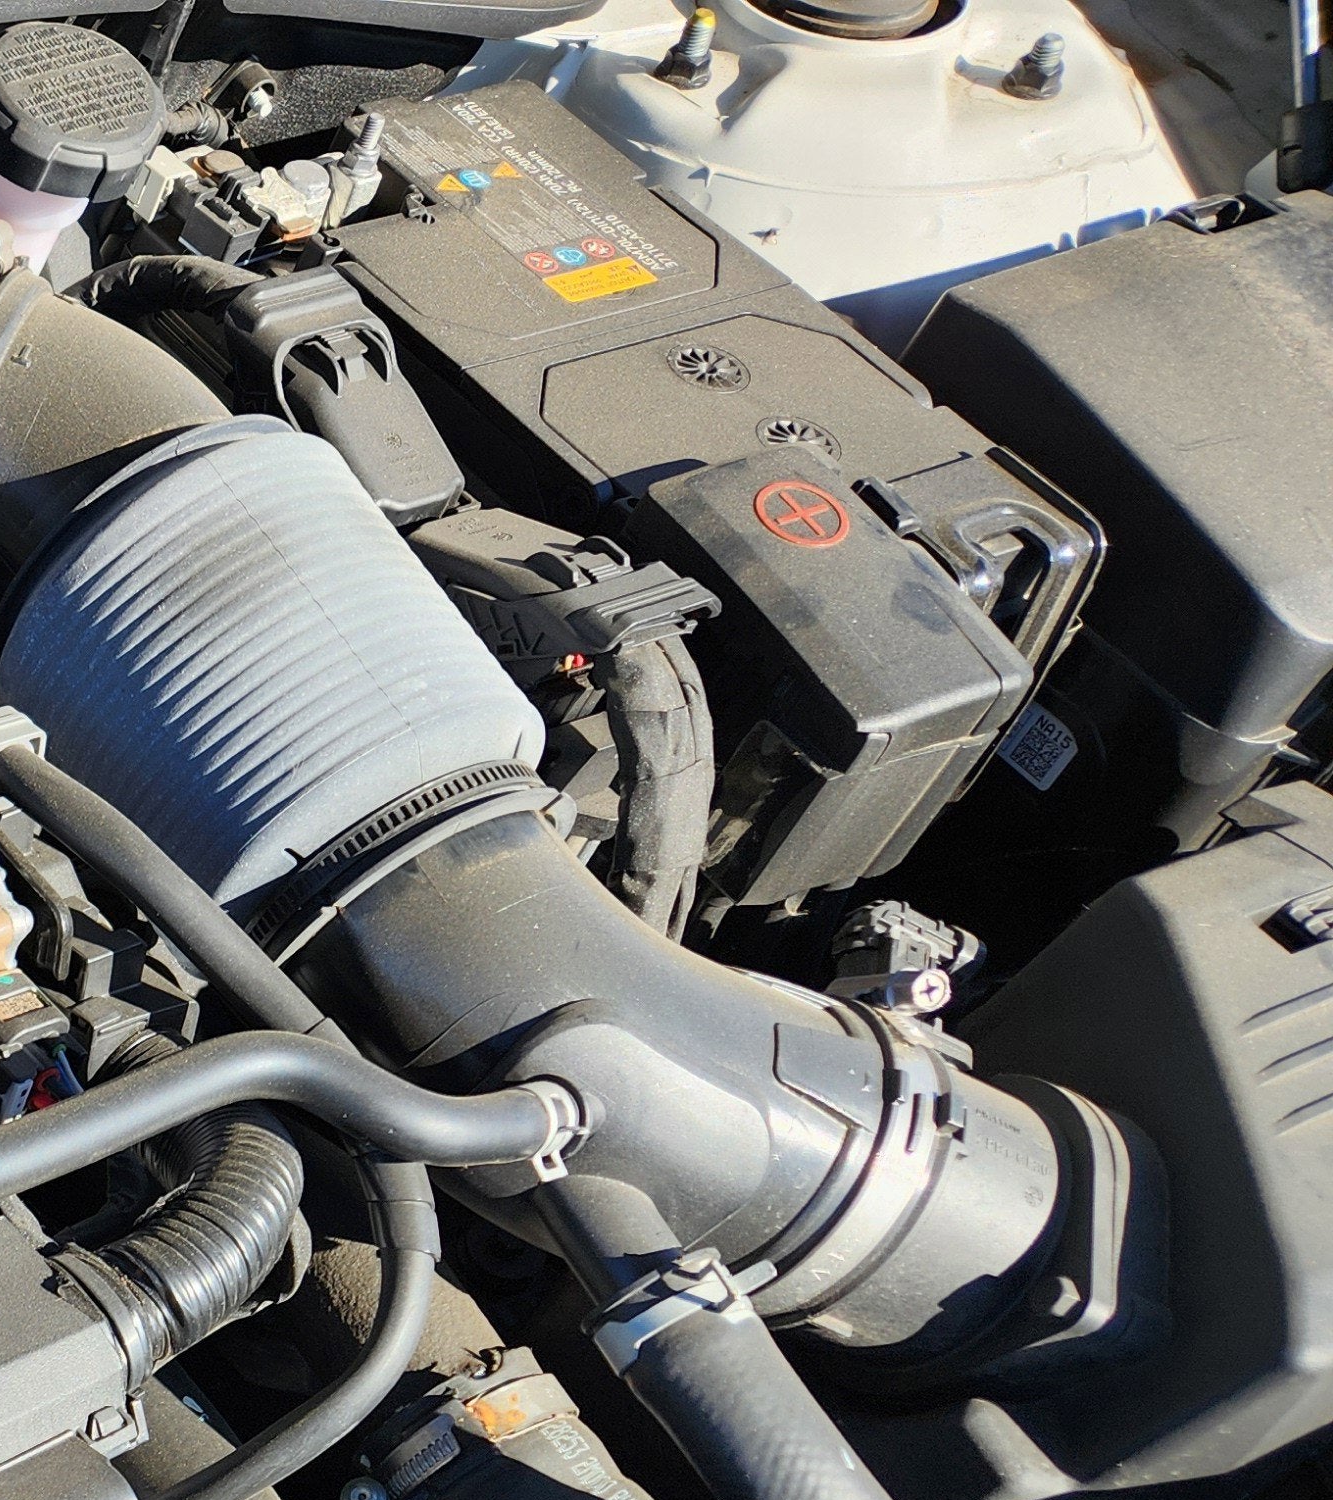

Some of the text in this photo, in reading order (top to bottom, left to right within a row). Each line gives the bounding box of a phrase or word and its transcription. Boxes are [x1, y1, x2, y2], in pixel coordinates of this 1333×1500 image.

[476, 125, 502, 143] CCA
[501, 144, 540, 175] (20HR)
[527, 150, 566, 183] 120min
[539, 174, 568, 197] 70Ah
[566, 179, 583, 194] RC
[1035, 714, 1073, 750] NA15
[543, 1420, 591, 1460] 28253
